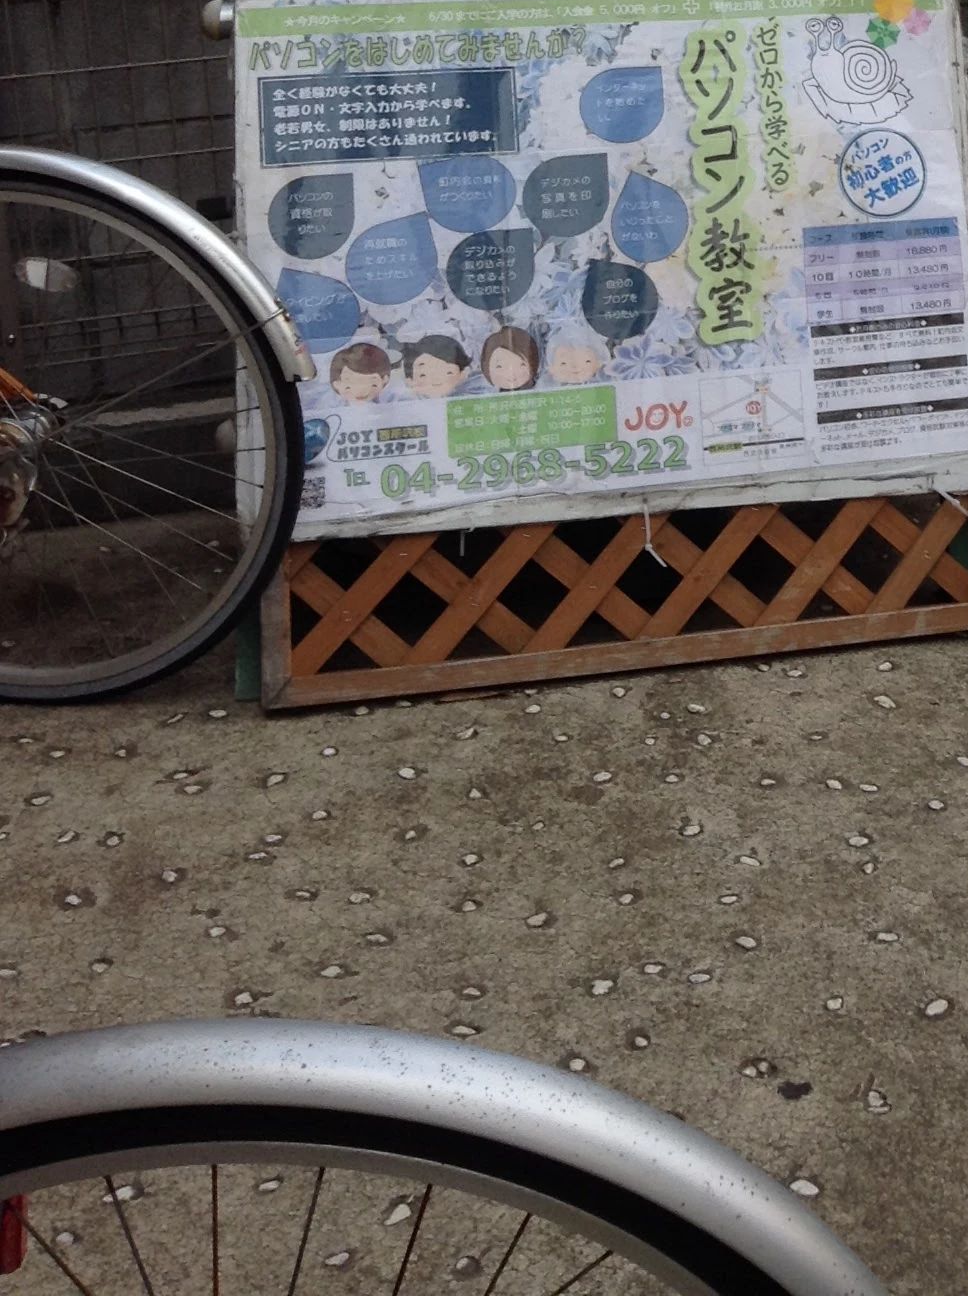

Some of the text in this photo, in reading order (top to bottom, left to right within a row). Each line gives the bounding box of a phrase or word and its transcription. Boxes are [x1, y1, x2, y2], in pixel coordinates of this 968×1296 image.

[756, 23, 791, 187] ゼロから学べる
[688, 29, 756, 335] パソコン教室
[846, 150, 913, 191] 初心者の方
[864, 167, 920, 208] 大歓迎
[623, 399, 688, 432] JOY
[336, 429, 374, 446] JOY
[343, 434, 692, 501] TEL 04-2968-5222
